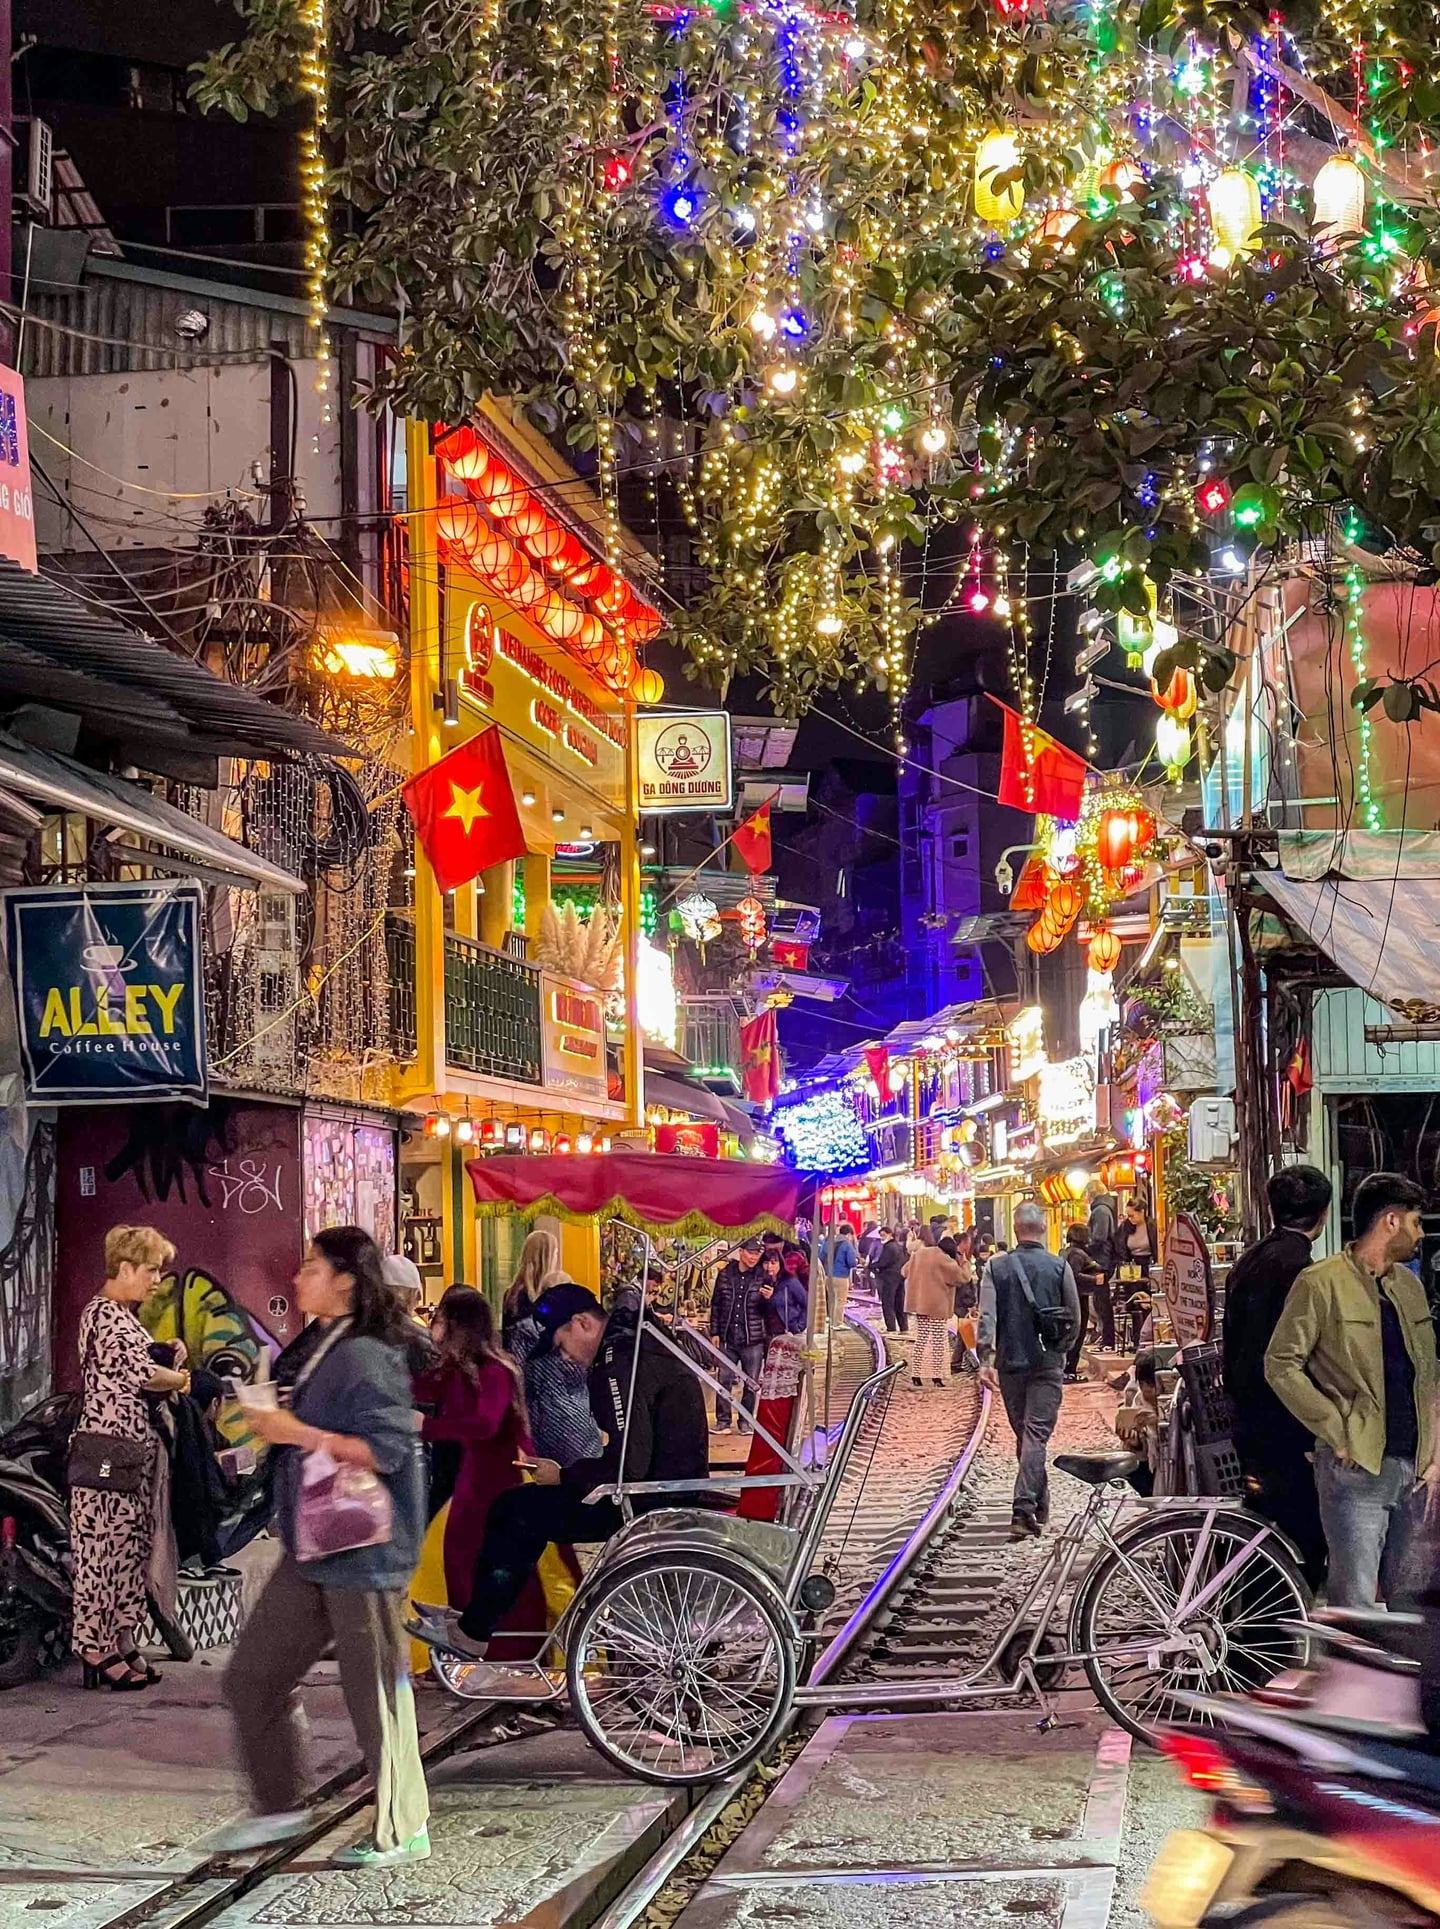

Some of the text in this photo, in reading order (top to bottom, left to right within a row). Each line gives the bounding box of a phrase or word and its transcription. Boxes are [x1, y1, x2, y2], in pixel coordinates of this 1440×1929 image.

[643, 783, 656, 795] GA
[39, 983, 185, 1037] ALLEY
[49, 1040, 181, 1054] Coffee House
